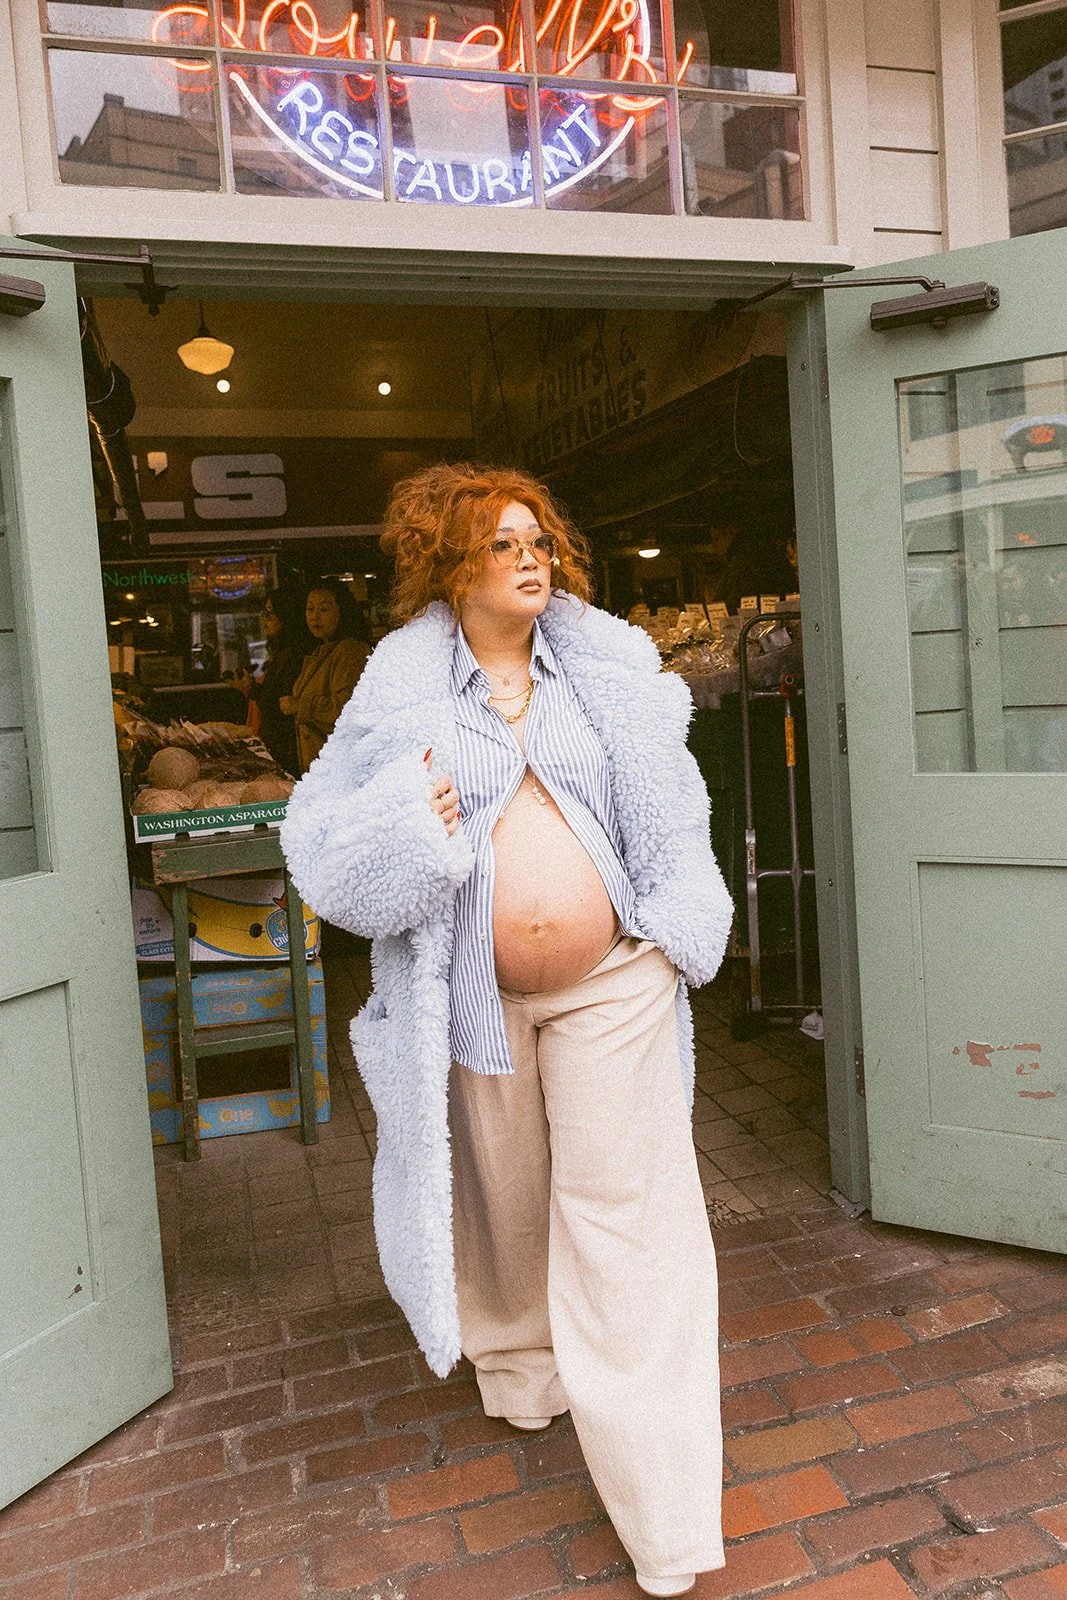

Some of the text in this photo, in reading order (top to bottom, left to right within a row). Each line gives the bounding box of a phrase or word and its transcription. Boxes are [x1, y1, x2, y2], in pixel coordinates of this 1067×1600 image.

[277, 82, 602, 203] RESTAURANT
[536, 338, 604, 418] FRUITS
[102, 568, 193, 588] Northwest
[144, 807, 288, 831] WASHINGTON ASPARAGU
[273, 932, 289, 948] Chi
